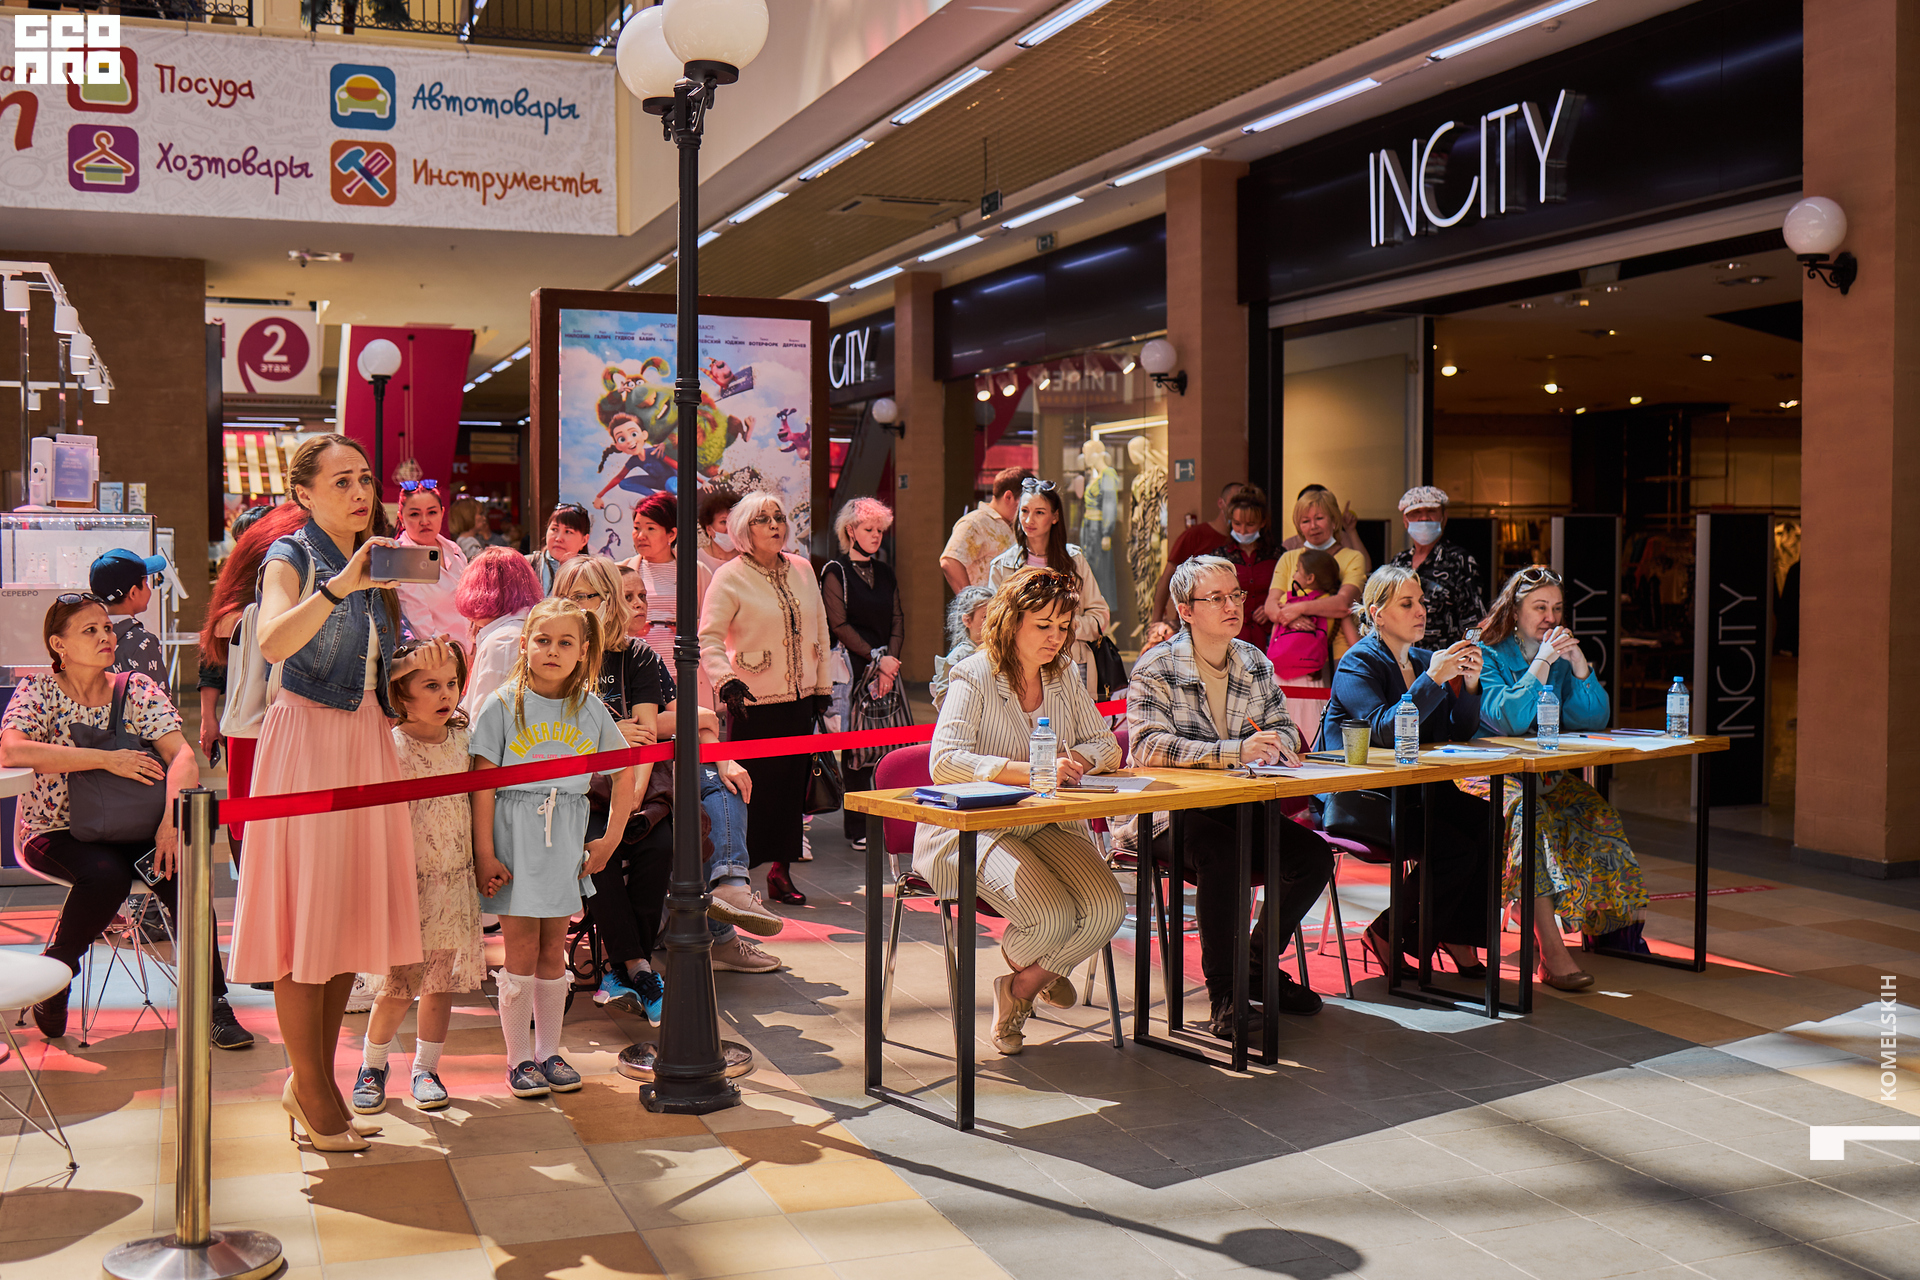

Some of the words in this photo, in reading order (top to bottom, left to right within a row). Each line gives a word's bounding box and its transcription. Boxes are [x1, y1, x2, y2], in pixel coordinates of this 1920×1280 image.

[154, 63, 255, 108] Посуда
[412, 81, 580, 135] Автотовары
[156, 142, 314, 195] Хозтовары
[413, 158, 602, 205] Инструменты
[1369, 88, 1566, 247] INCITY
[263, 325, 288, 362] 2
[828, 326, 870, 390] CITY
[260, 363, 291, 373] этаж
[1, 590, 39, 598] СЕРЕБРО
[1716, 582, 1757, 738] INCITY
[508, 722, 550, 759] NEVER
[551, 721, 583, 749] GIVE
